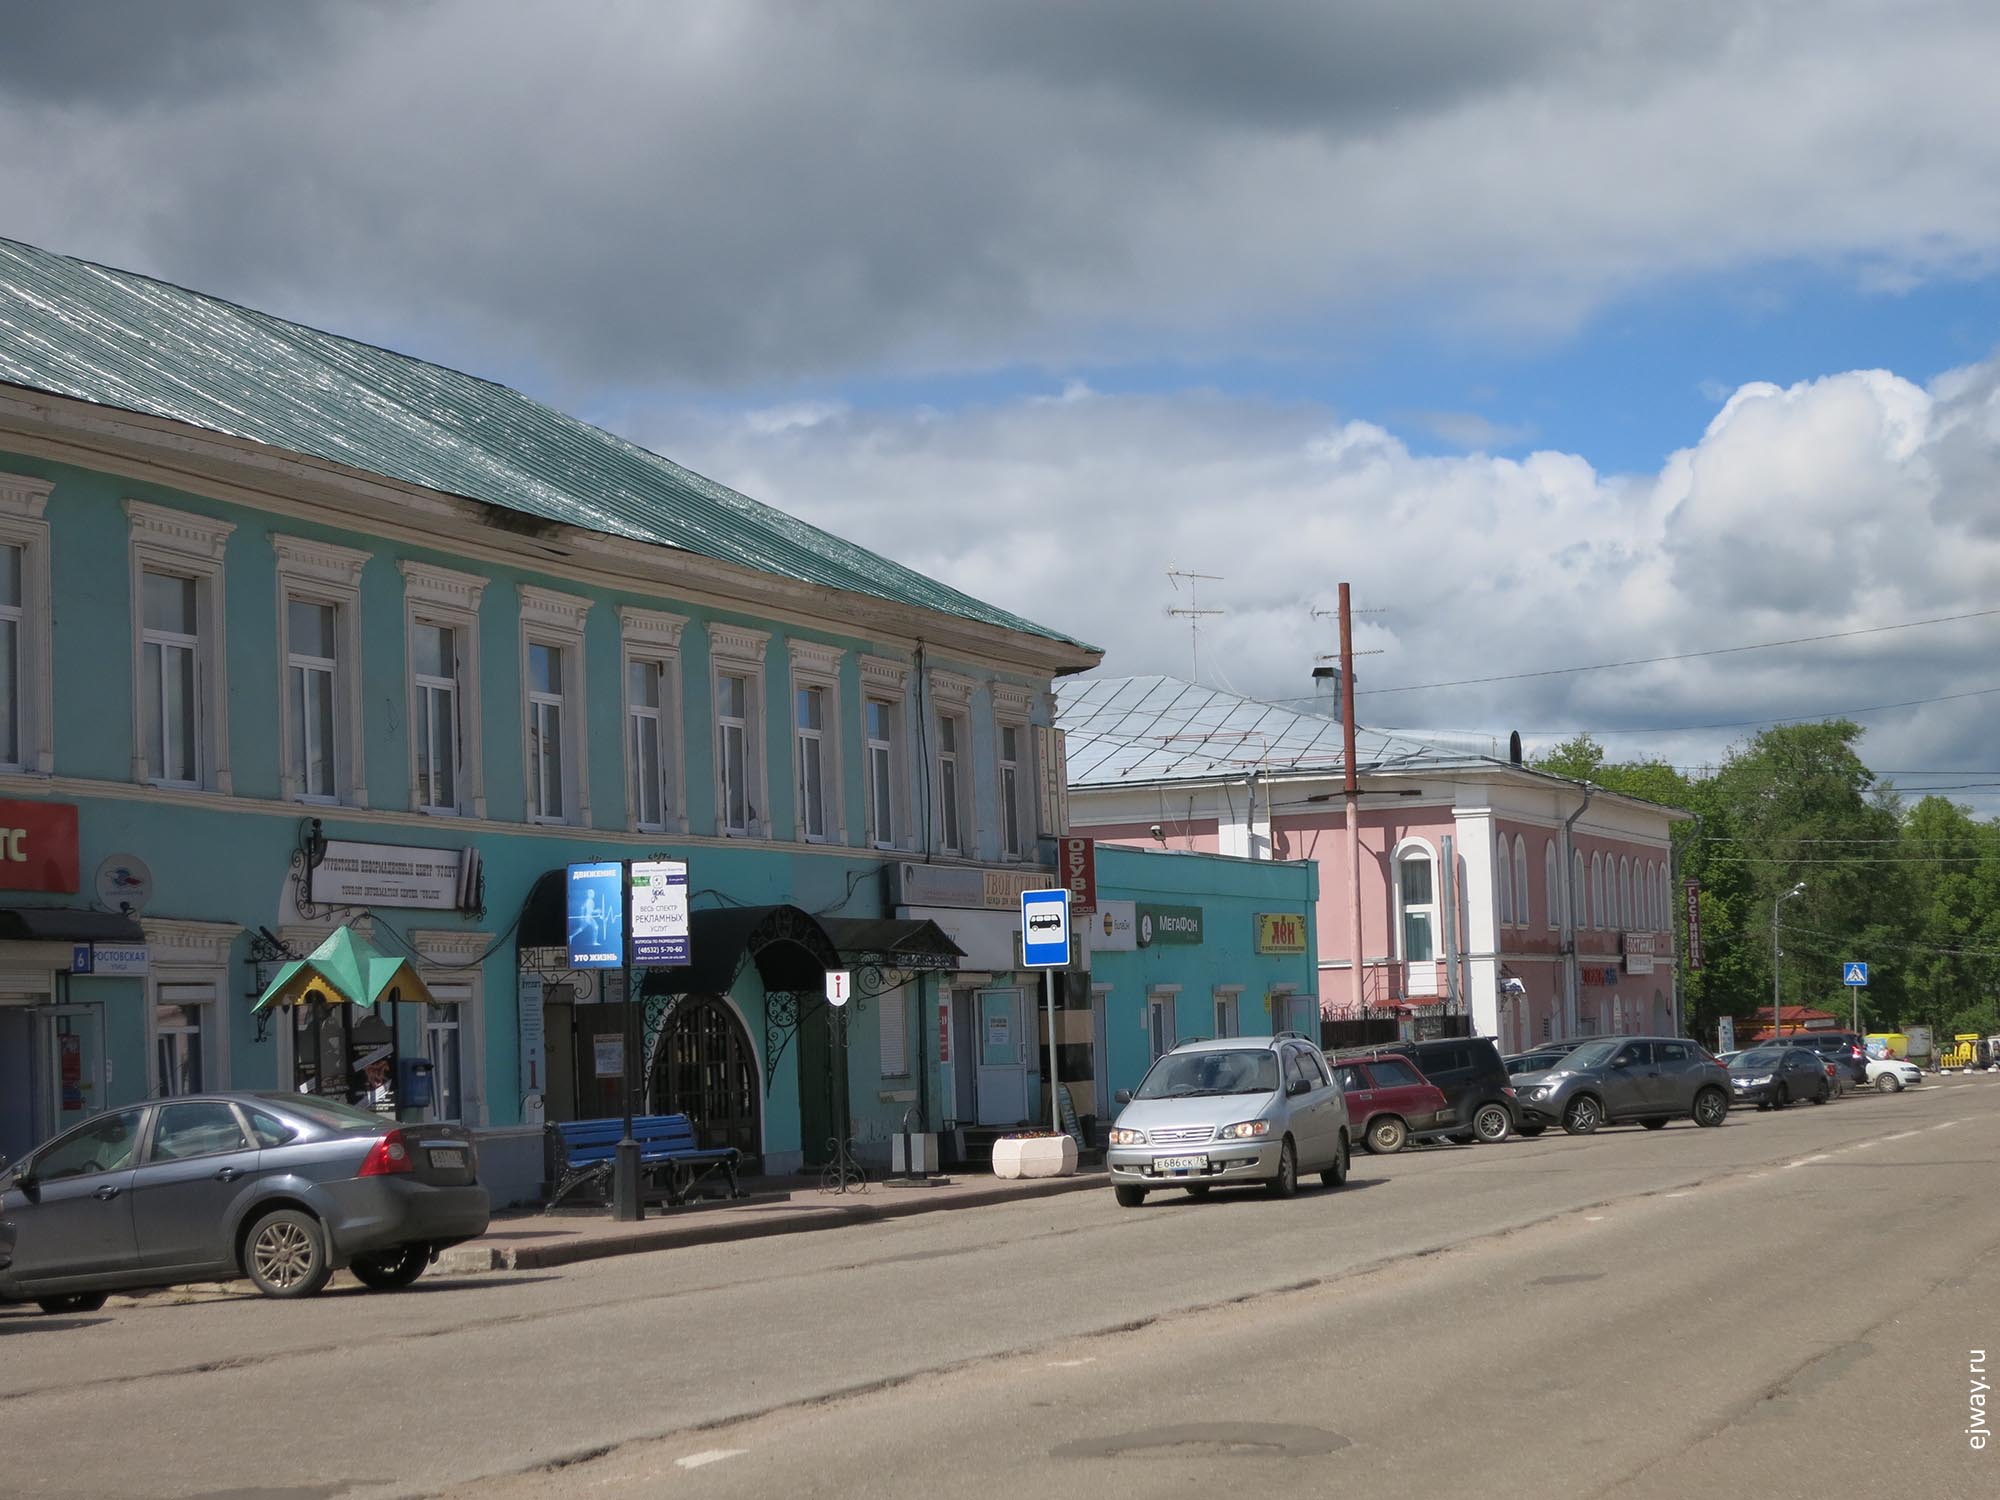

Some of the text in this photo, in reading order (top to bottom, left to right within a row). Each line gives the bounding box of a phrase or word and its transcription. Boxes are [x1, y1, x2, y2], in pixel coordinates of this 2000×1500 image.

[573, 869, 617, 880] ДВИЖЕНИЕ
[1068, 839, 1087, 903] ОБУВЬ
[986, 873, 1011, 895] ТВОЙ
[635, 914, 684, 923] РЕКЛАМНЫХ
[1687, 887, 1700, 968] ГОСТИНИЦА
[661, 945, 683, 954] 5-70-60
[77, 951, 145, 966] 6 РОСТОВСКАЯ
[574, 952, 618, 962] ЭТО ЖИЗНЬ
